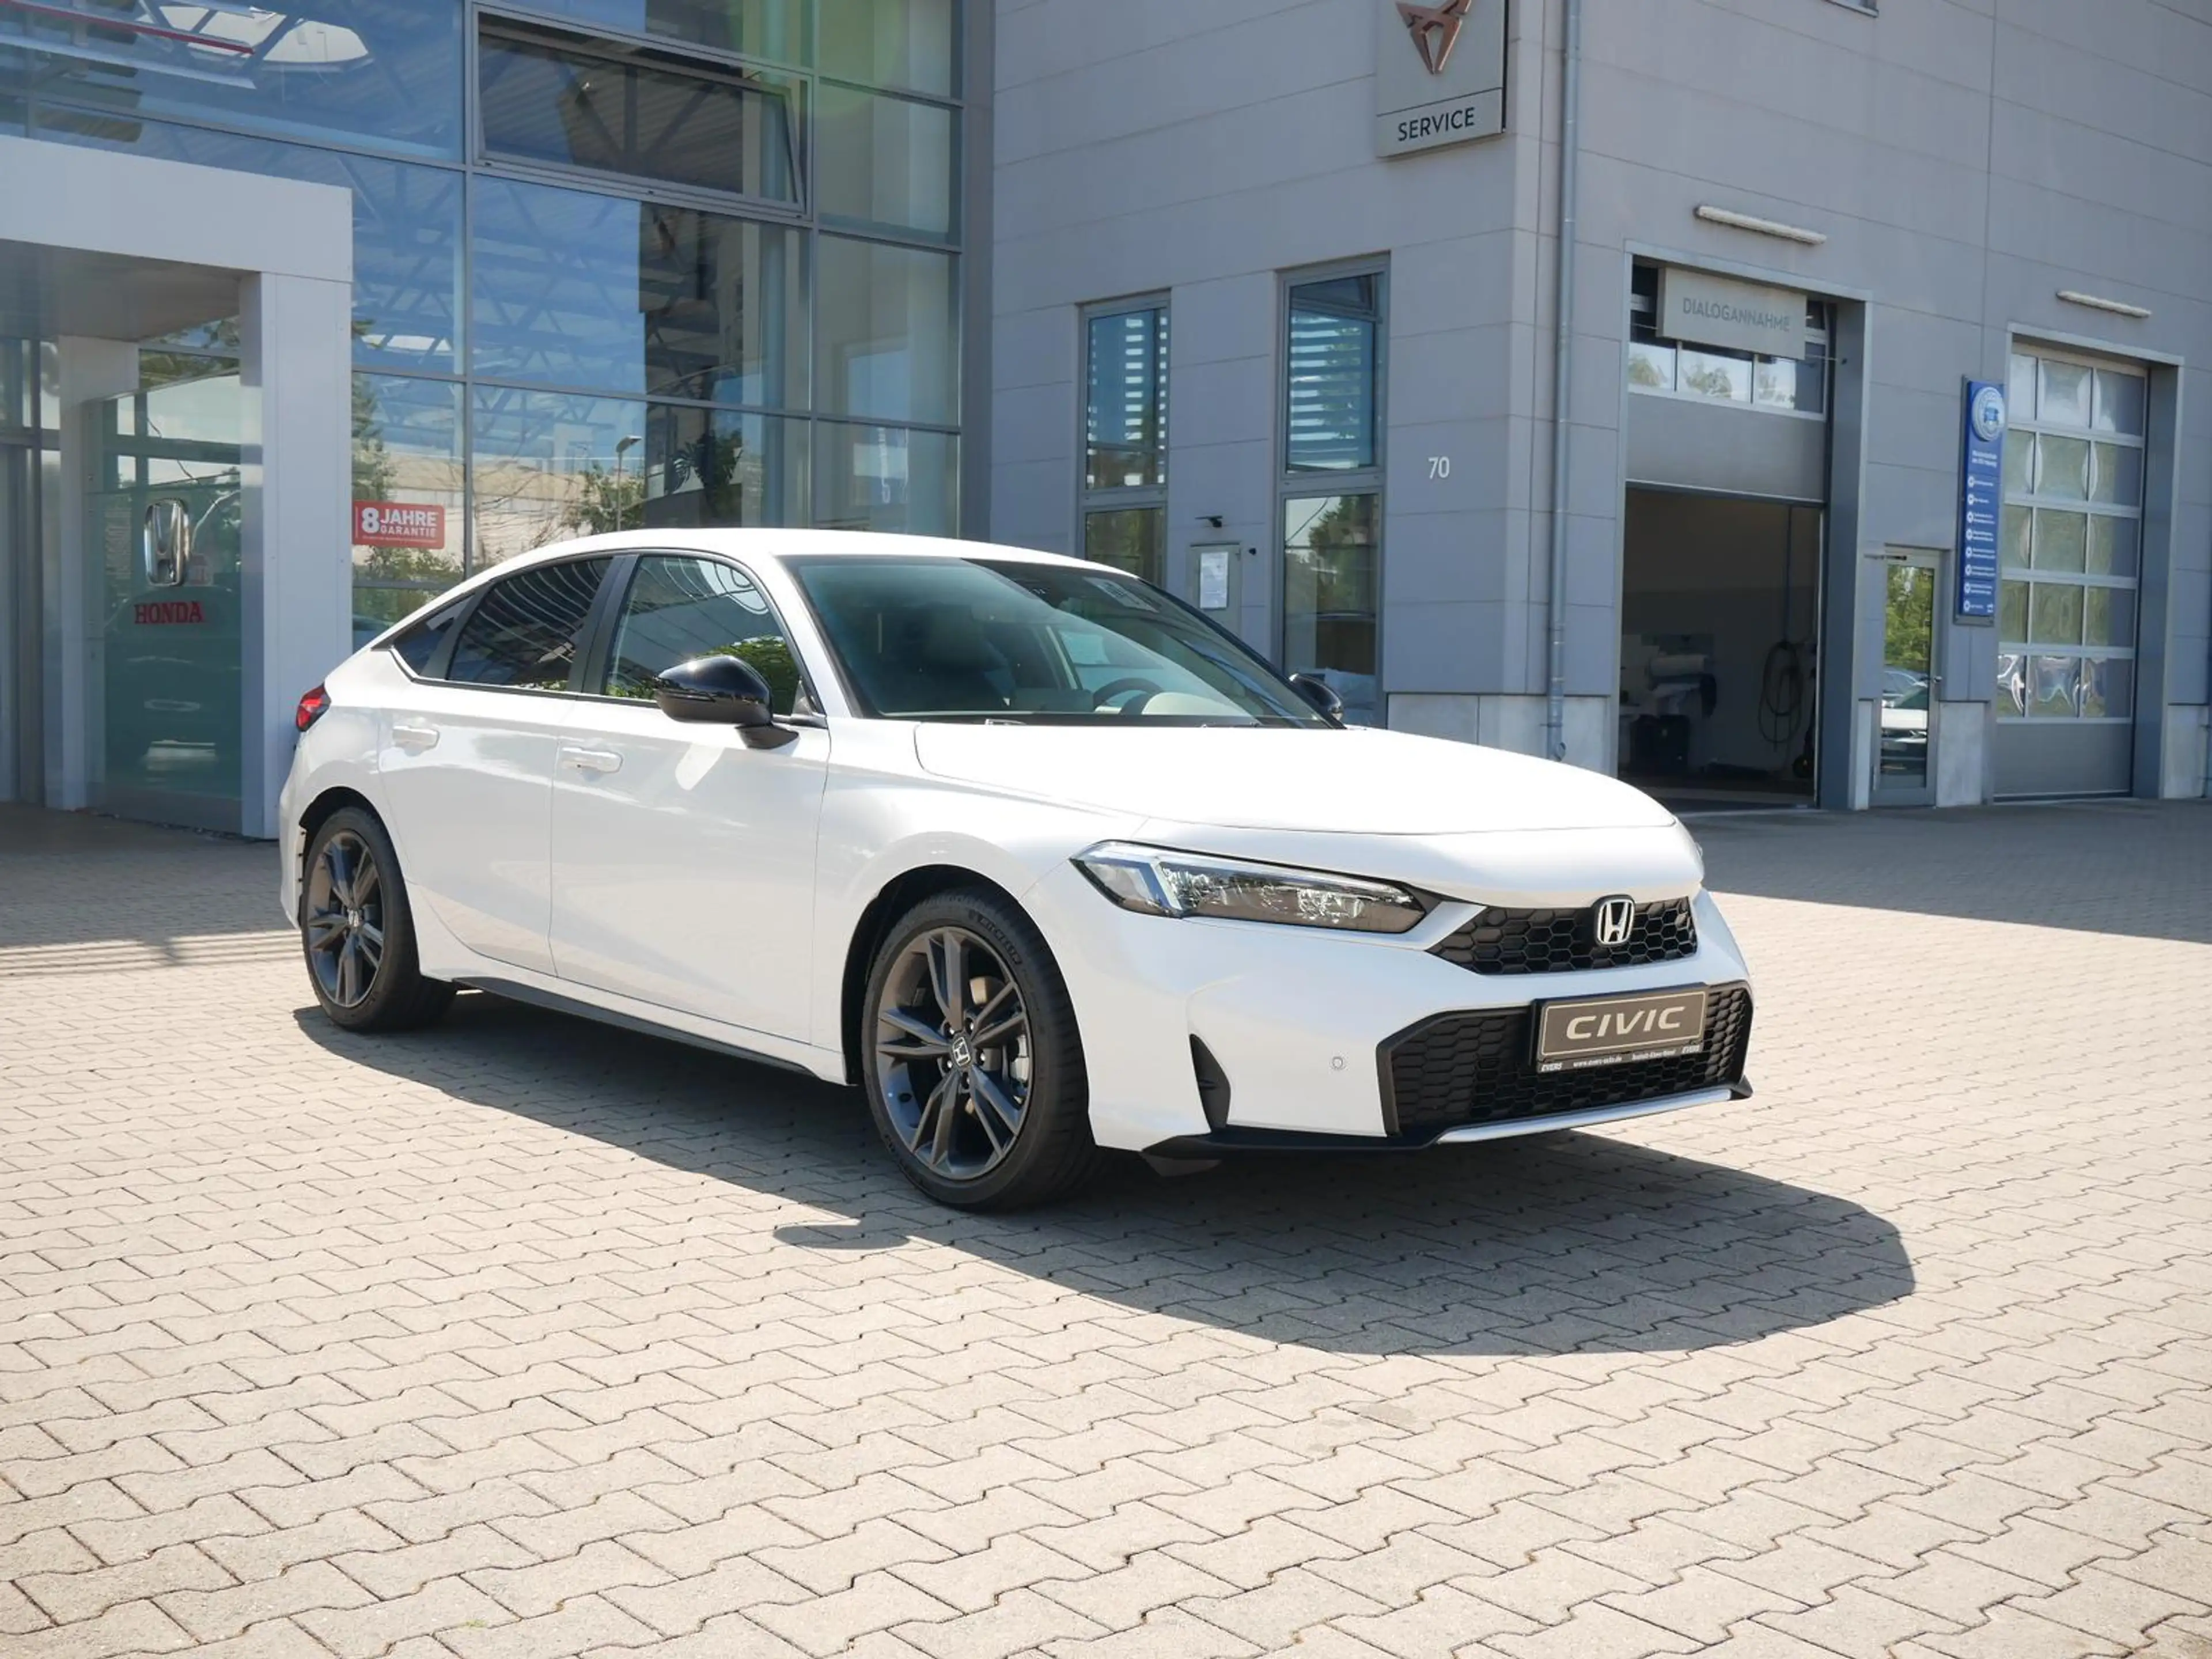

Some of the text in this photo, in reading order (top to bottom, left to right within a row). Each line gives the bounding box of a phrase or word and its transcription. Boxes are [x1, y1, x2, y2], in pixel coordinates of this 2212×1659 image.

[1398, 107, 1475, 142] SERVICE
[1683, 297, 1790, 332] DIALOGANNAHME
[1428, 456, 1450, 480] 70
[361, 507, 439, 533] 8 JAHRE
[380, 524, 437, 539] GARANTIE
[134, 600, 206, 624] HONDA
[1565, 1006, 1686, 1040] CIVIC
